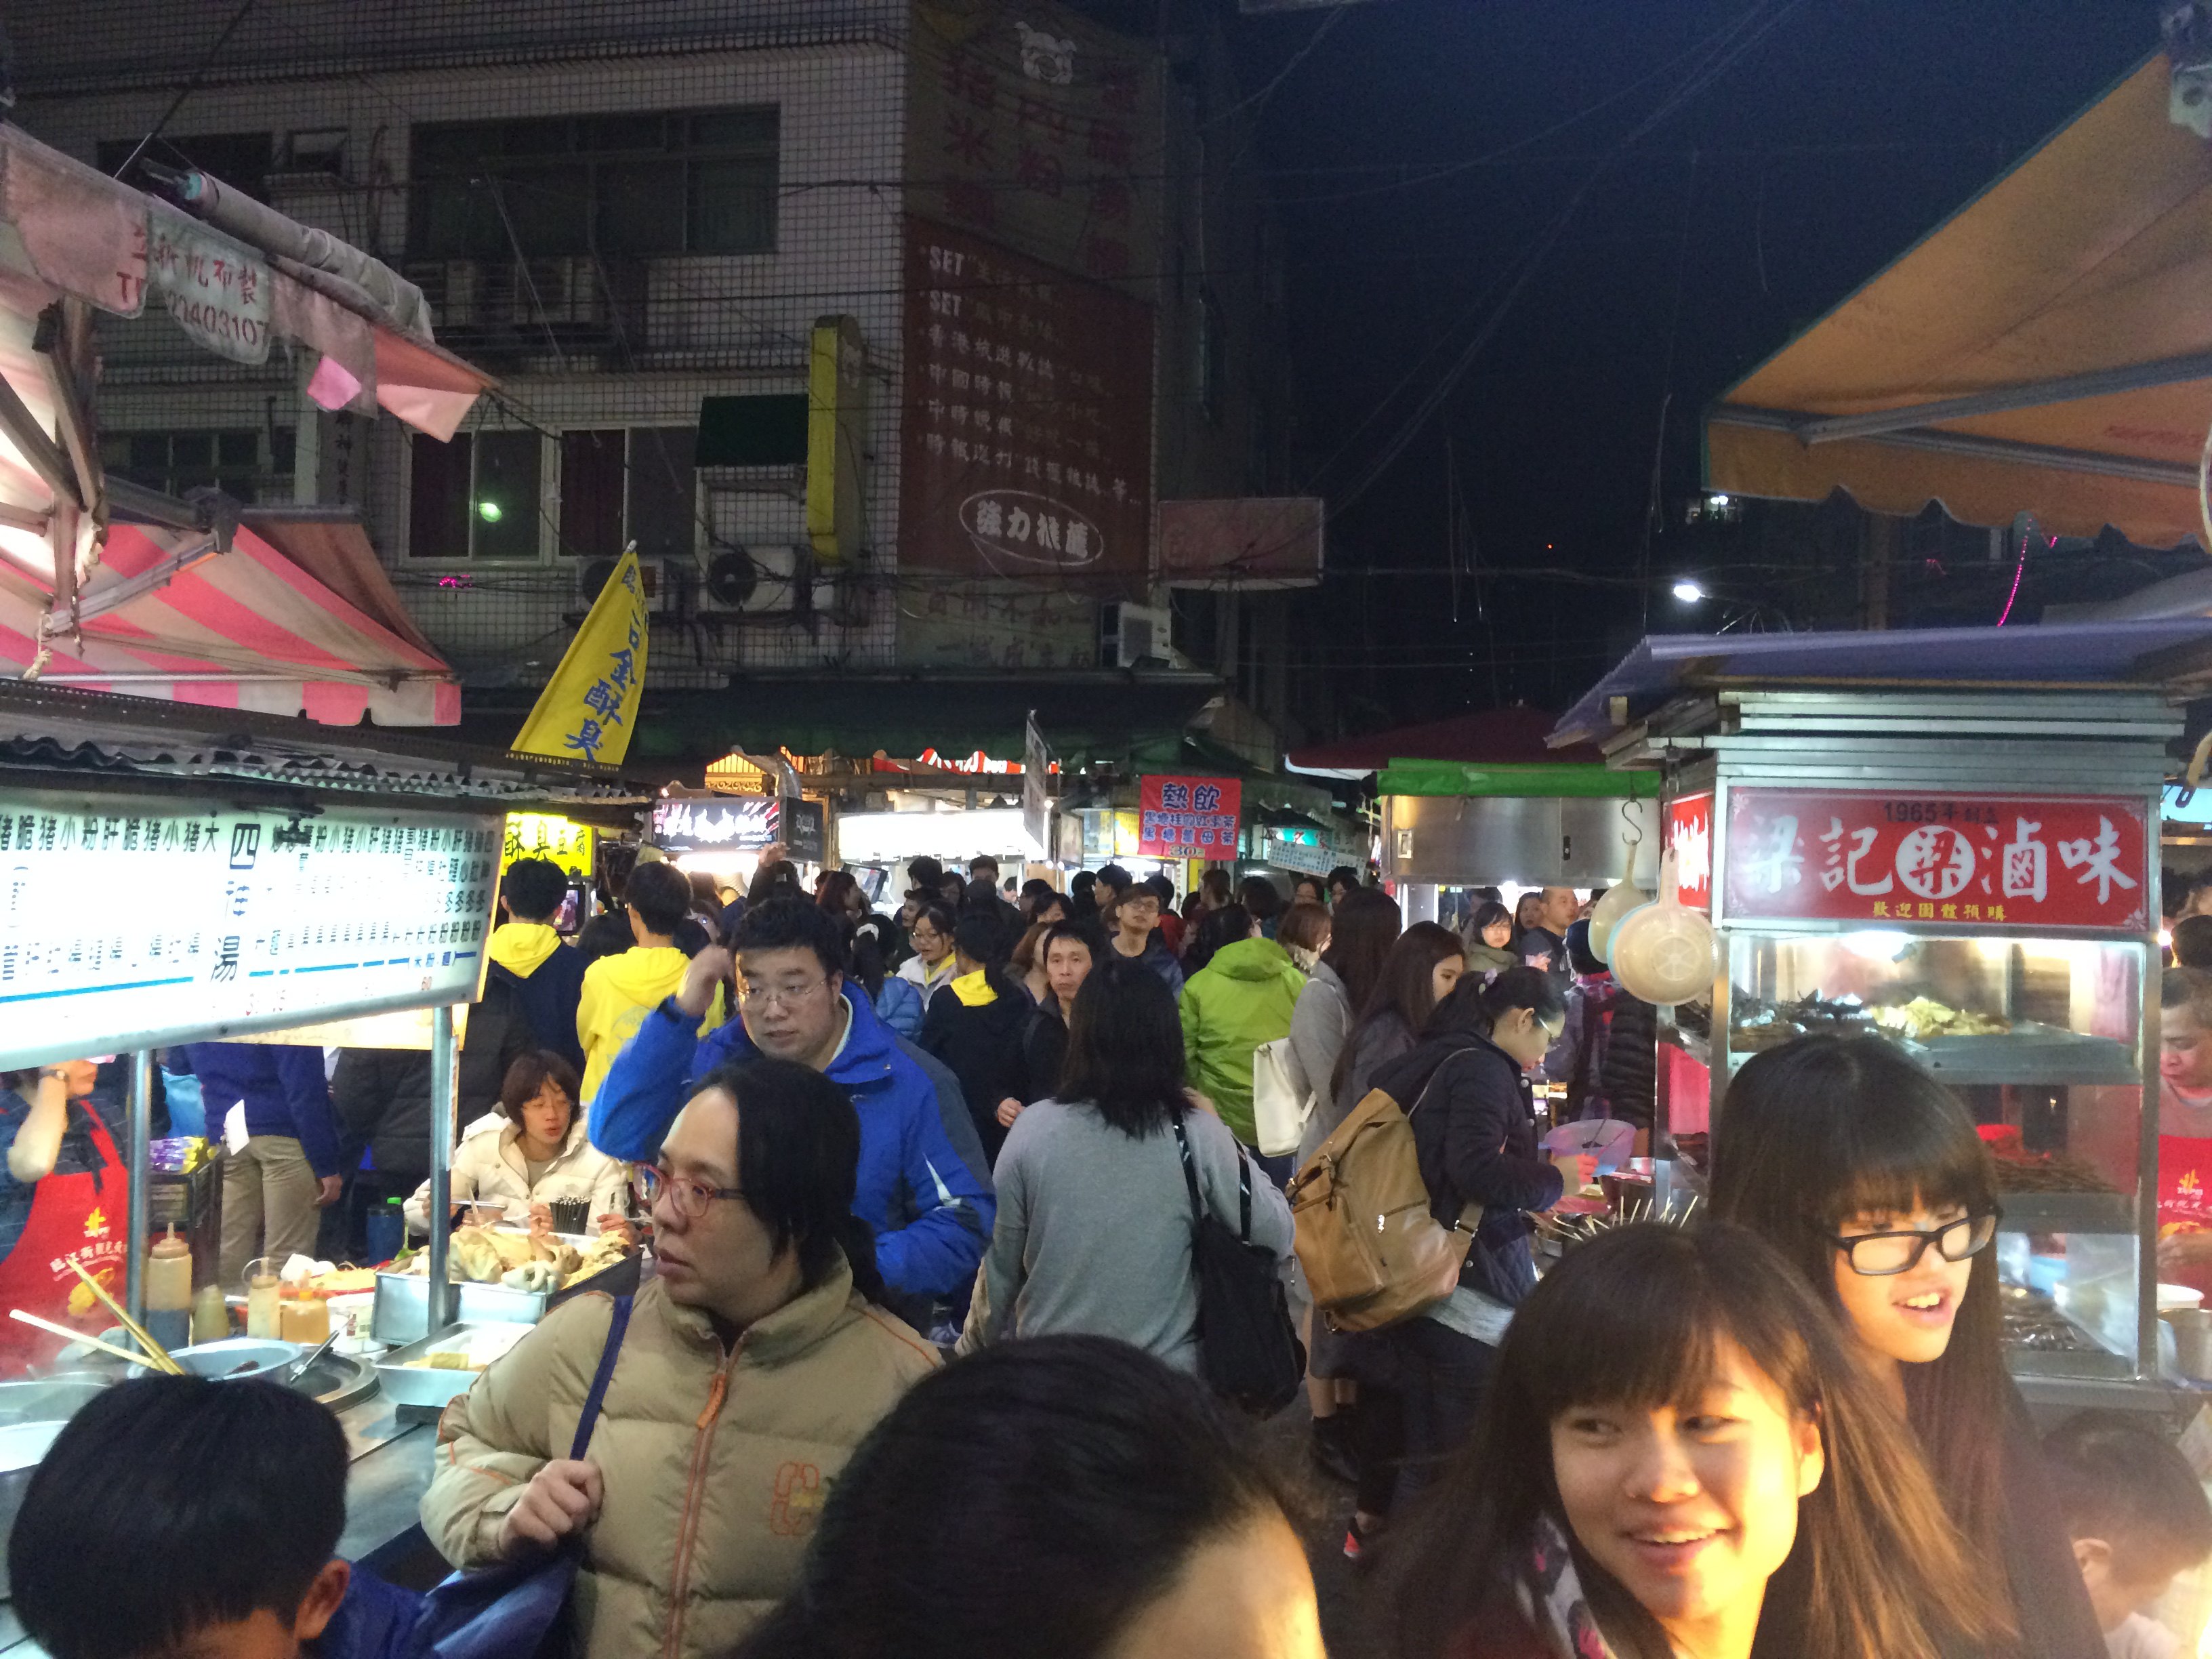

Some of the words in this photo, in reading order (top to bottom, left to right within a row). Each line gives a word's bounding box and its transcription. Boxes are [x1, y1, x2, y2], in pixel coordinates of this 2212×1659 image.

[929, 245, 965, 276] SET
[929, 289, 963, 318] SET
[975, 499, 1089, 558] 強力推薦
[1163, 782, 1221, 812] 熱飲
[1143, 826, 1235, 846] 黑糖薑母茶
[1742, 815, 1893, 895] 梁記
[1980, 815, 2138, 905] 滷味
